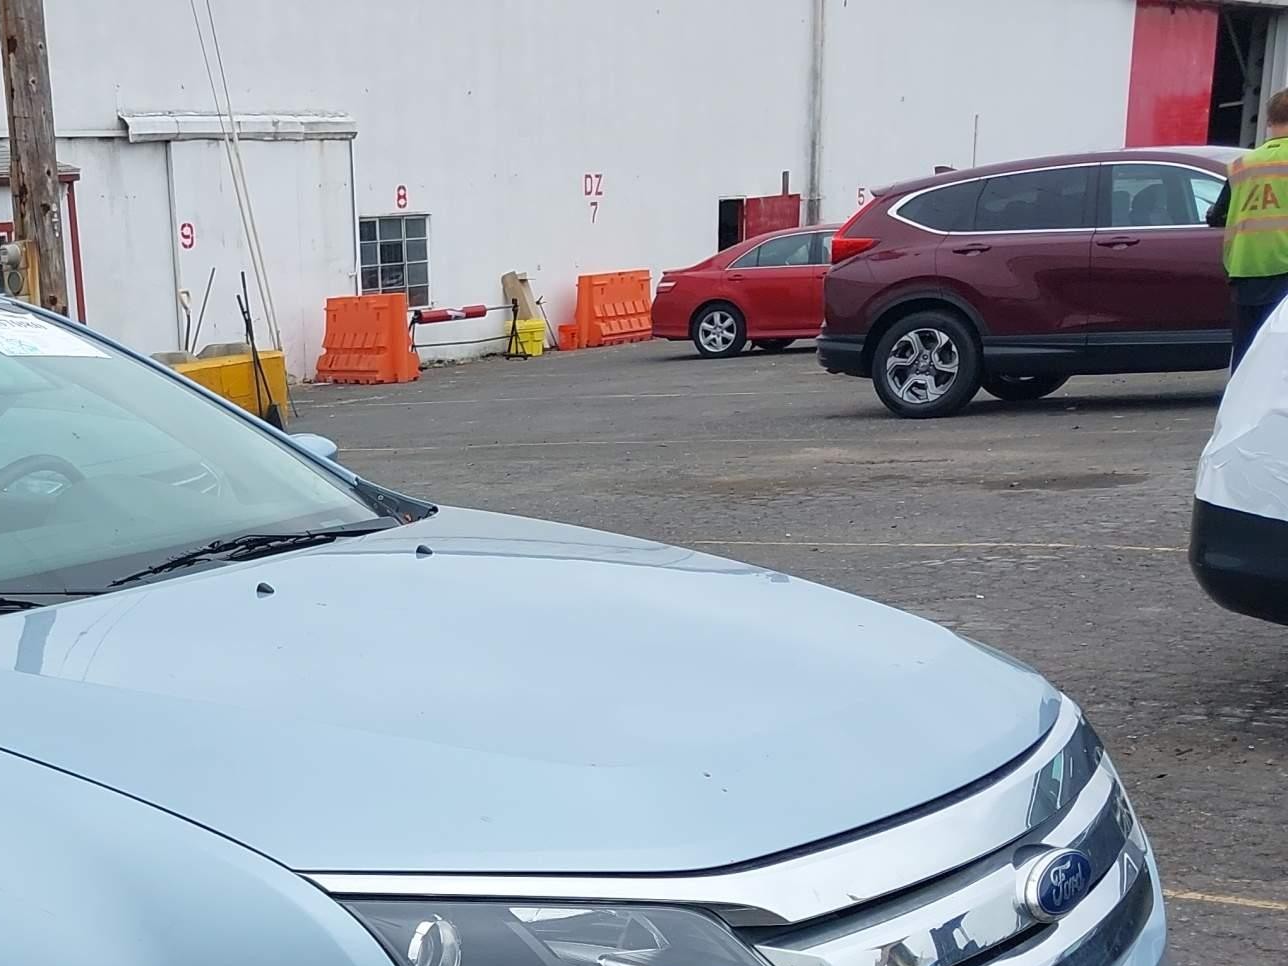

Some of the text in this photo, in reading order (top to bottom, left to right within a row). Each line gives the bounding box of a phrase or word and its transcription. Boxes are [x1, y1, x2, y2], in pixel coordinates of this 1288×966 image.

[584, 174, 603, 196] DZ
[396, 185, 409, 209] 8
[857, 188, 866, 206] 5
[590, 201, 598, 224] 7
[180, 222, 195, 250] 9
[1050, 860, 1083, 907] Ford
